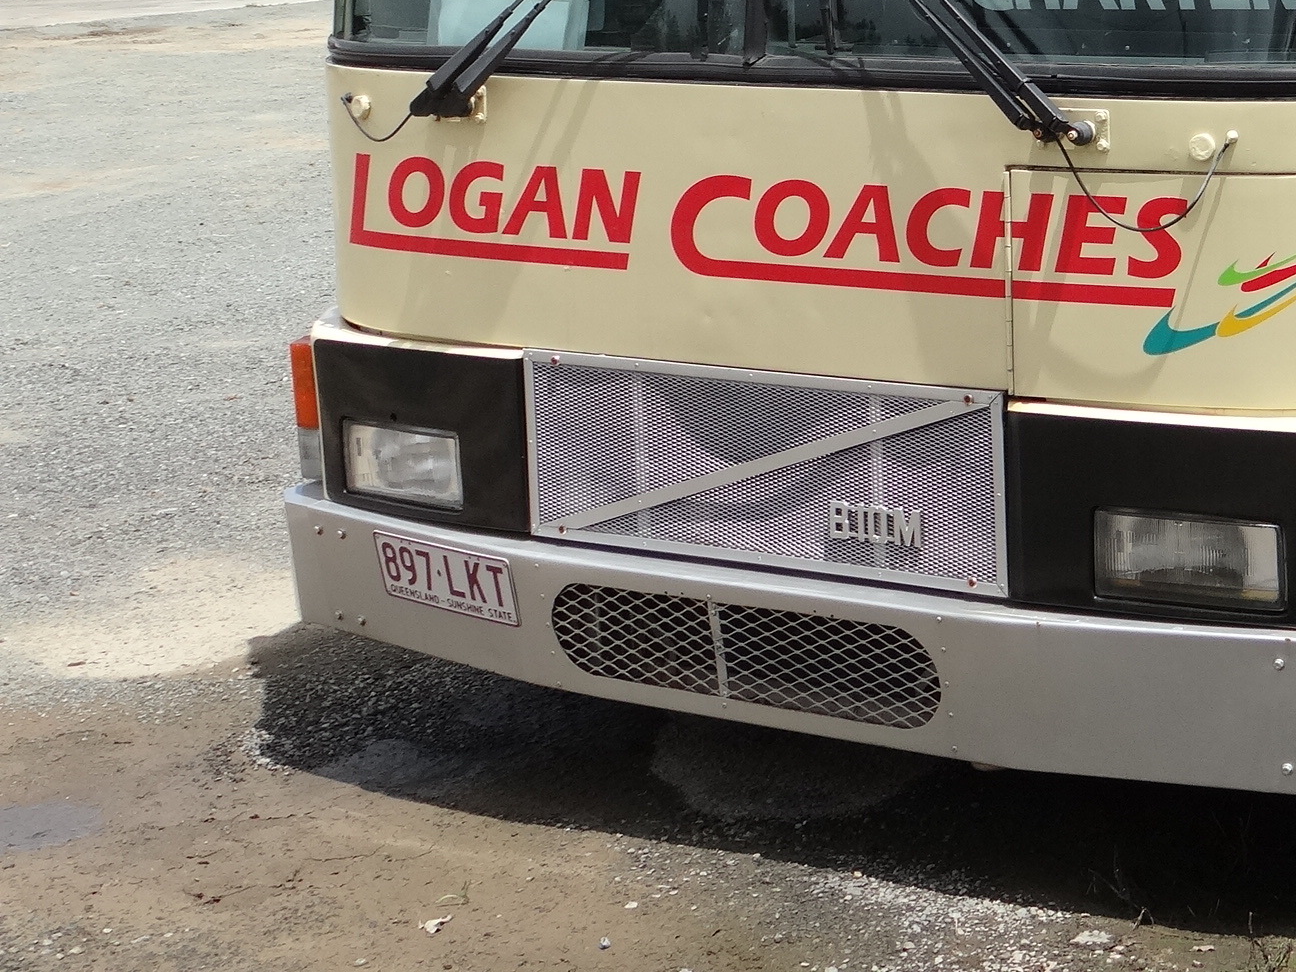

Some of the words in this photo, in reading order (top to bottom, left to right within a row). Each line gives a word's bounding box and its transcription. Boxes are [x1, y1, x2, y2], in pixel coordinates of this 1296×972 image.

[350, 153, 642, 271] LOGAN
[671, 174, 1188, 308] COACHES
[390, 583, 440, 605] QUEENSLAND
[446, 598, 485, 617] SUNSHINE
